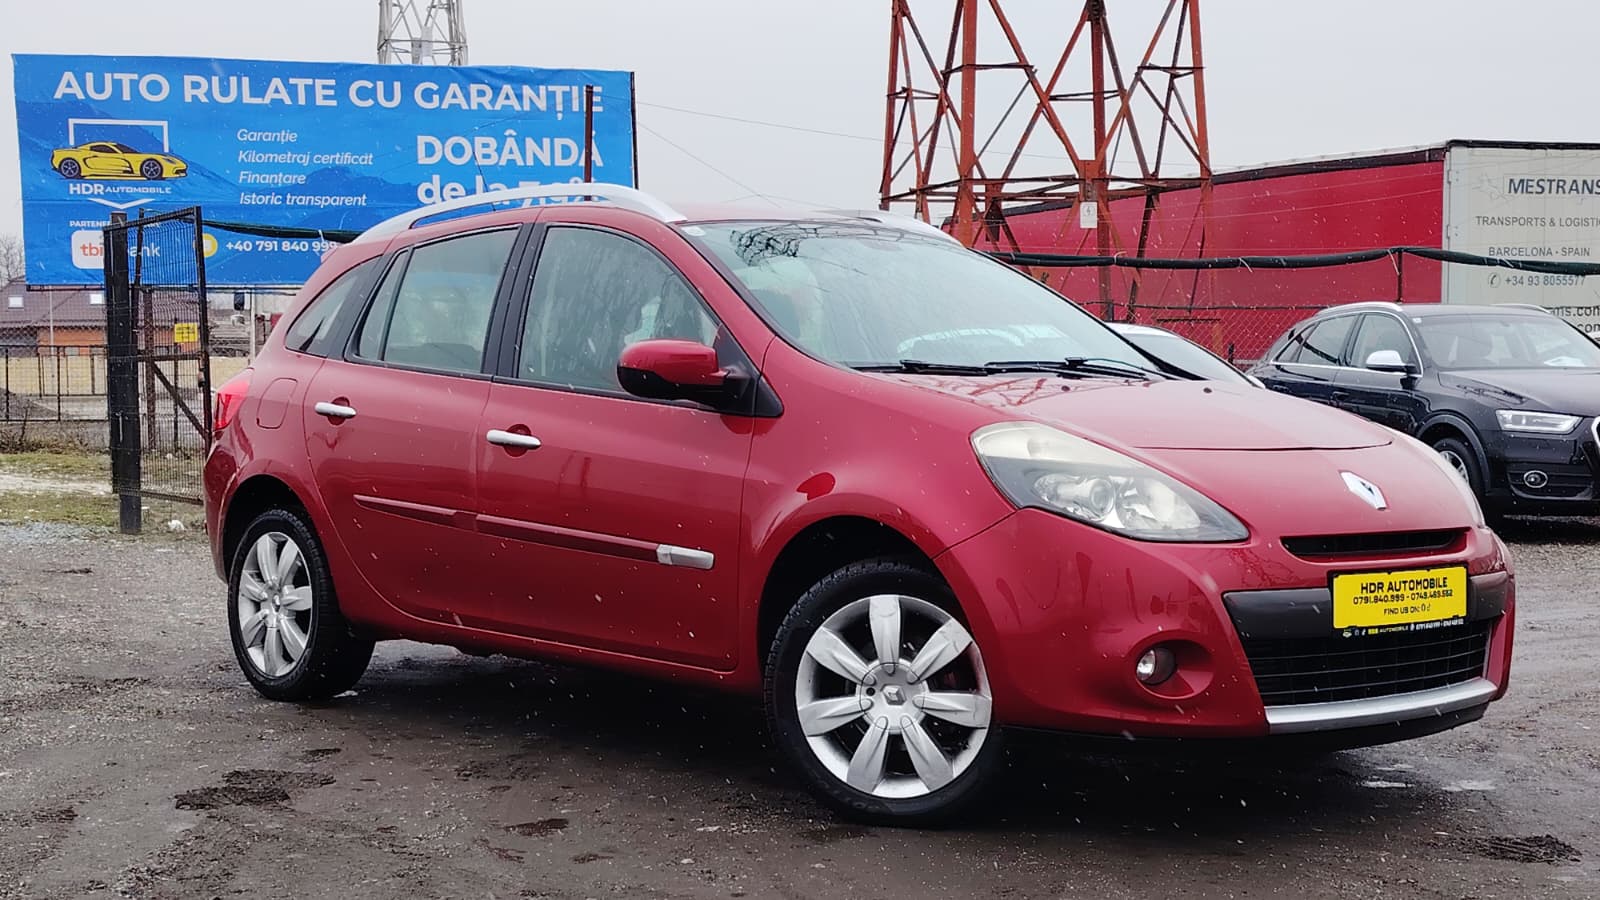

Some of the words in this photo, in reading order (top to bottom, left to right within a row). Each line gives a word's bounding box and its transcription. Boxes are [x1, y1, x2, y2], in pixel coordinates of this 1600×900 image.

[53, 71, 170, 102] AUTO
[184, 75, 338, 107] RULATE
[349, 80, 401, 108] CU
[238, 150, 311, 166] Kilometraj
[313, 152, 374, 165] certificat
[69, 183, 105, 195] HDR
[105, 186, 172, 194] AUTOMOBILE
[417, 175, 466, 205] de
[240, 193, 282, 205] Istoric
[286, 193, 367, 208] transparent
[1475, 216, 1546, 227] TRANSPORTS
[1549, 218, 1556, 227] &
[127, 242, 161, 257] ank
[226, 241, 252, 251] +40
[256, 241, 278, 252] 791
[282, 241, 309, 252] 840
[1488, 246, 1553, 257] BARCELONA
[1561, 247, 1590, 257] SPAIN
[1505, 275, 1524, 286] +34
[1528, 275, 1540, 286] 93
[1543, 275, 1586, 287] 8055577
[1361, 582, 1384, 594] HDR
[1387, 577, 1448, 593] AUTOMOBILE
